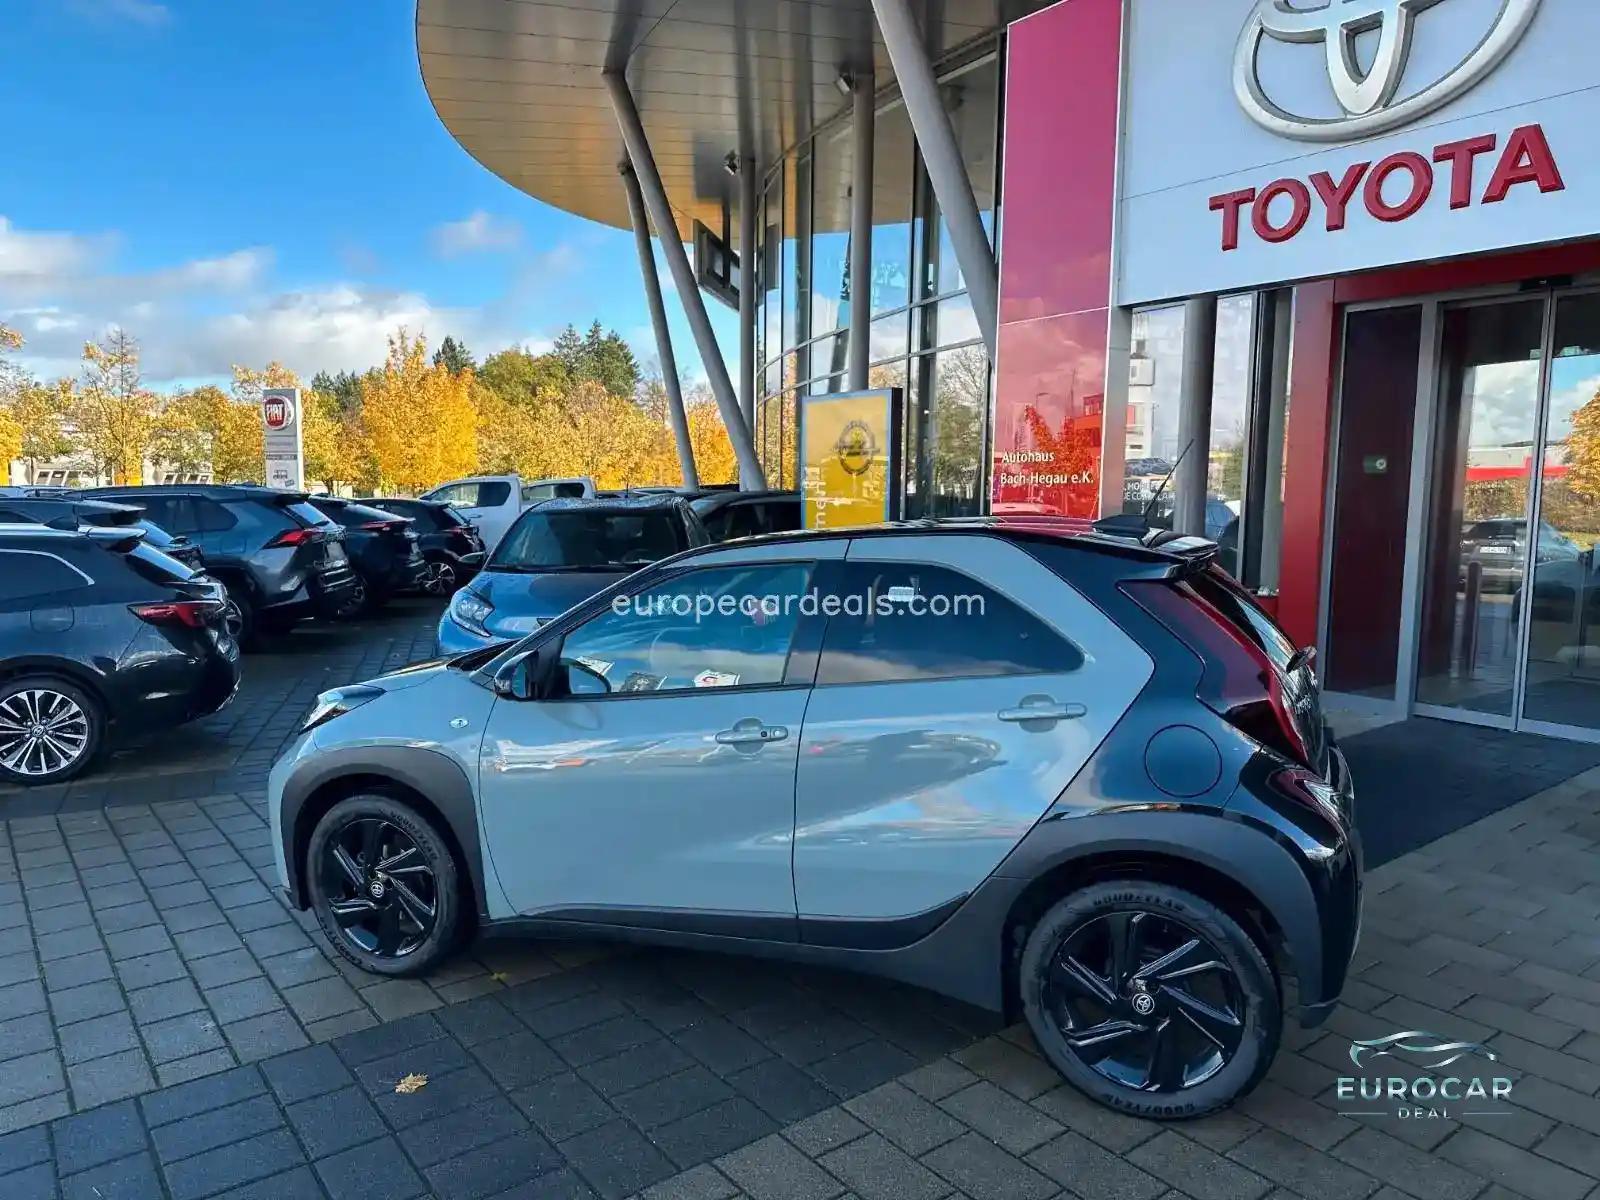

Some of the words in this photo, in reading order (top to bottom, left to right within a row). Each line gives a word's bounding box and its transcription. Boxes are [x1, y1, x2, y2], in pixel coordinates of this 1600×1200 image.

[1209, 123, 1565, 251] TOYOTA
[266, 404, 284, 421] FIAT
[1001, 451, 1055, 463] Autohaus
[1000, 472, 1068, 487] Bach-Hegau
[1071, 471, 1094, 484] e.K.
